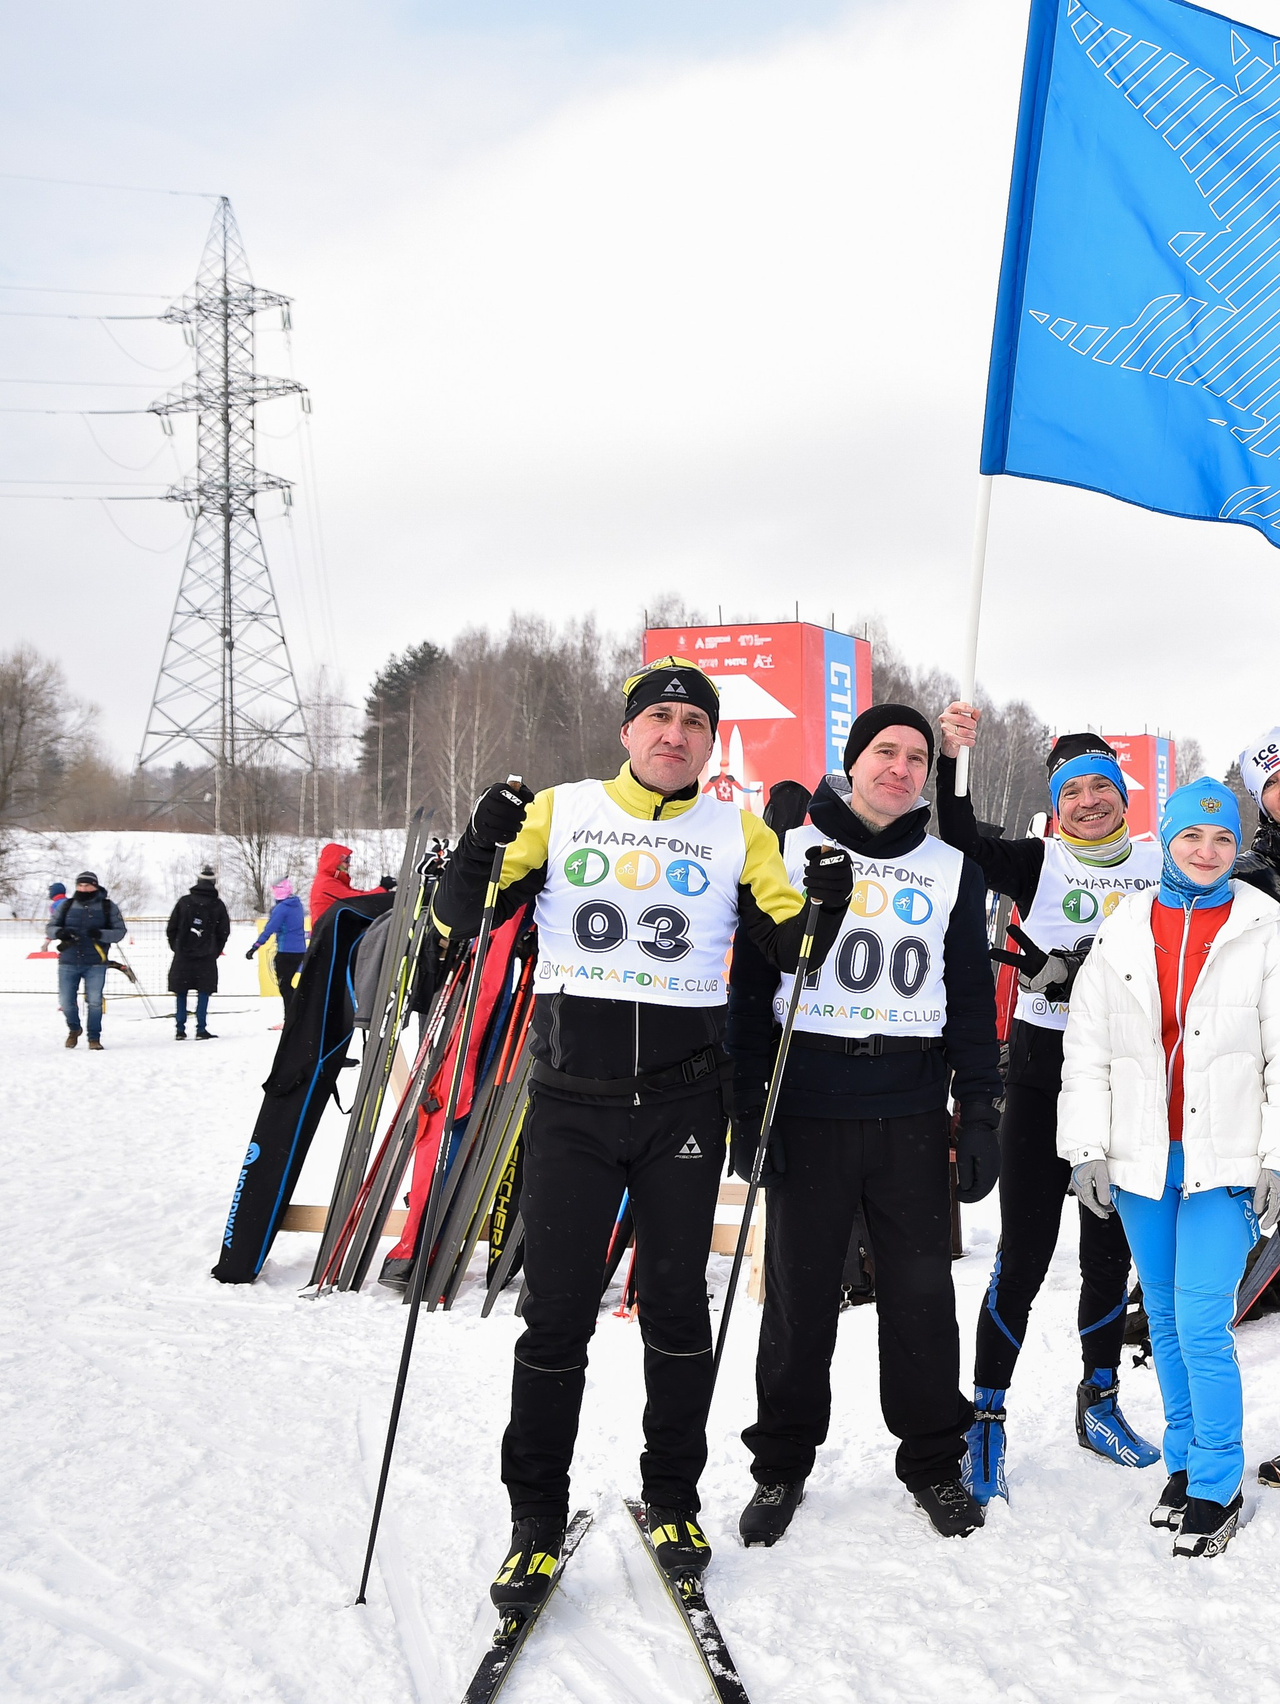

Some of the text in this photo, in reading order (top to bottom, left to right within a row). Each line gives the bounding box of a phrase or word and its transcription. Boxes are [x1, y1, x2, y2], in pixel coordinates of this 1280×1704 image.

[572, 830, 713, 861] VMARAFONE
[551, 963, 719, 992] VMARAFONE.CLUB
[803, 928, 931, 999] 00
[223, 1168, 249, 1249] NORDWAY
[1084, 1411, 1140, 1468] SPINE
